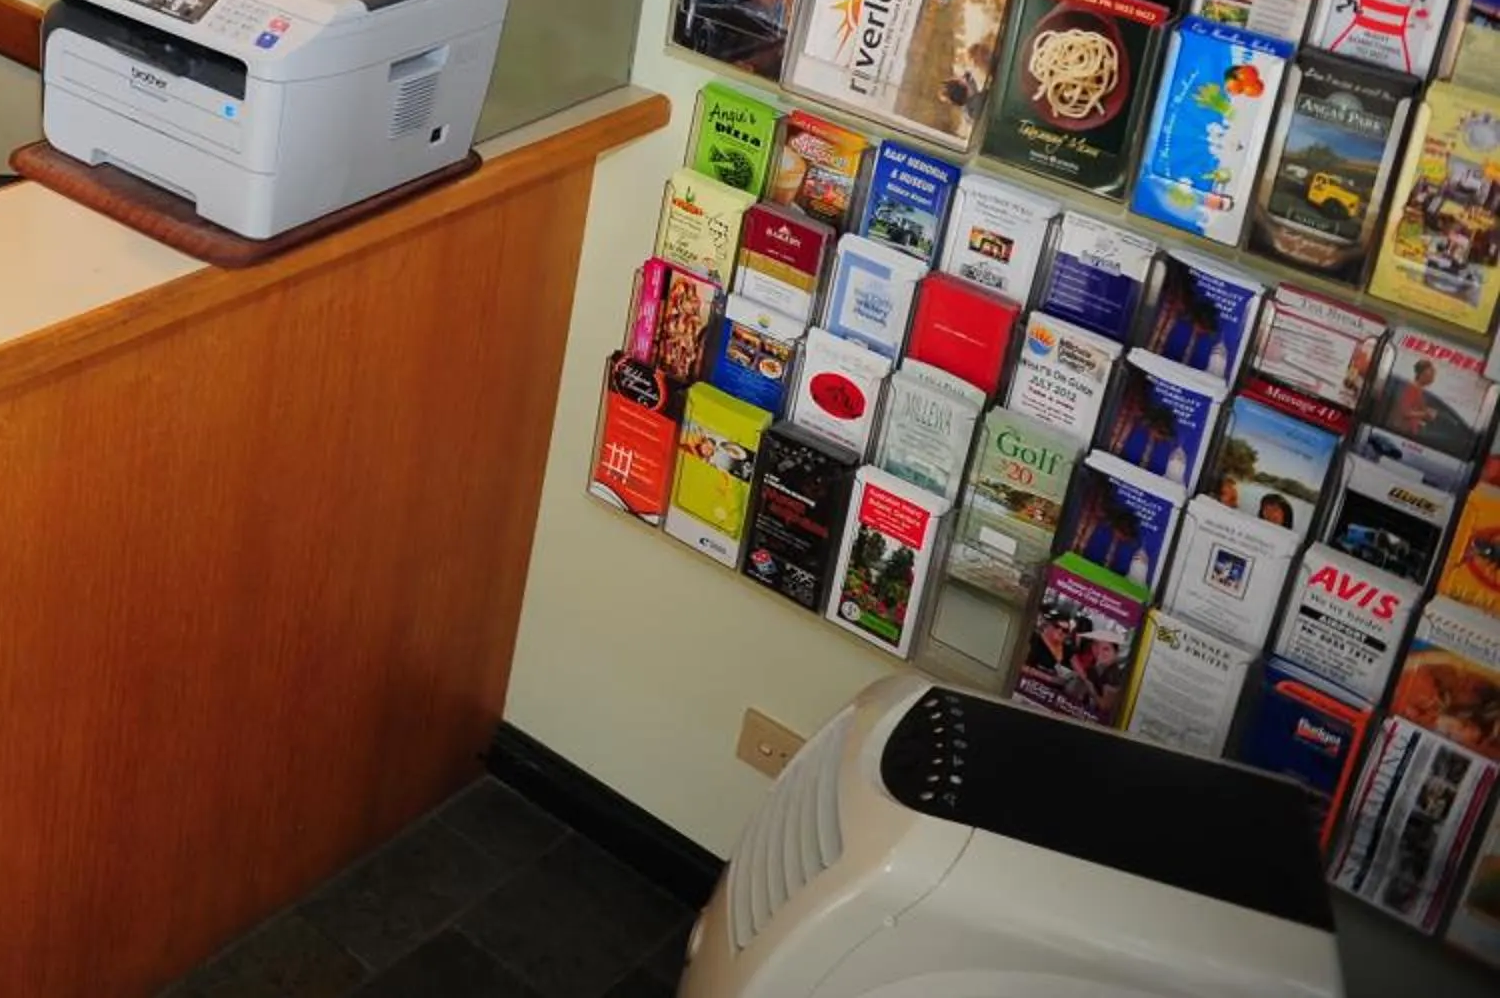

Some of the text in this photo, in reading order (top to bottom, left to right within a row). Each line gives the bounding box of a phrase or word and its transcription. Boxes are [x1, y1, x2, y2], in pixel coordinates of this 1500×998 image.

[131, 66, 169, 89] brother
[1265, 385, 1316, 414] Massage
[995, 428, 1064, 476] Golf
[1308, 566, 1401, 619] AVIS
